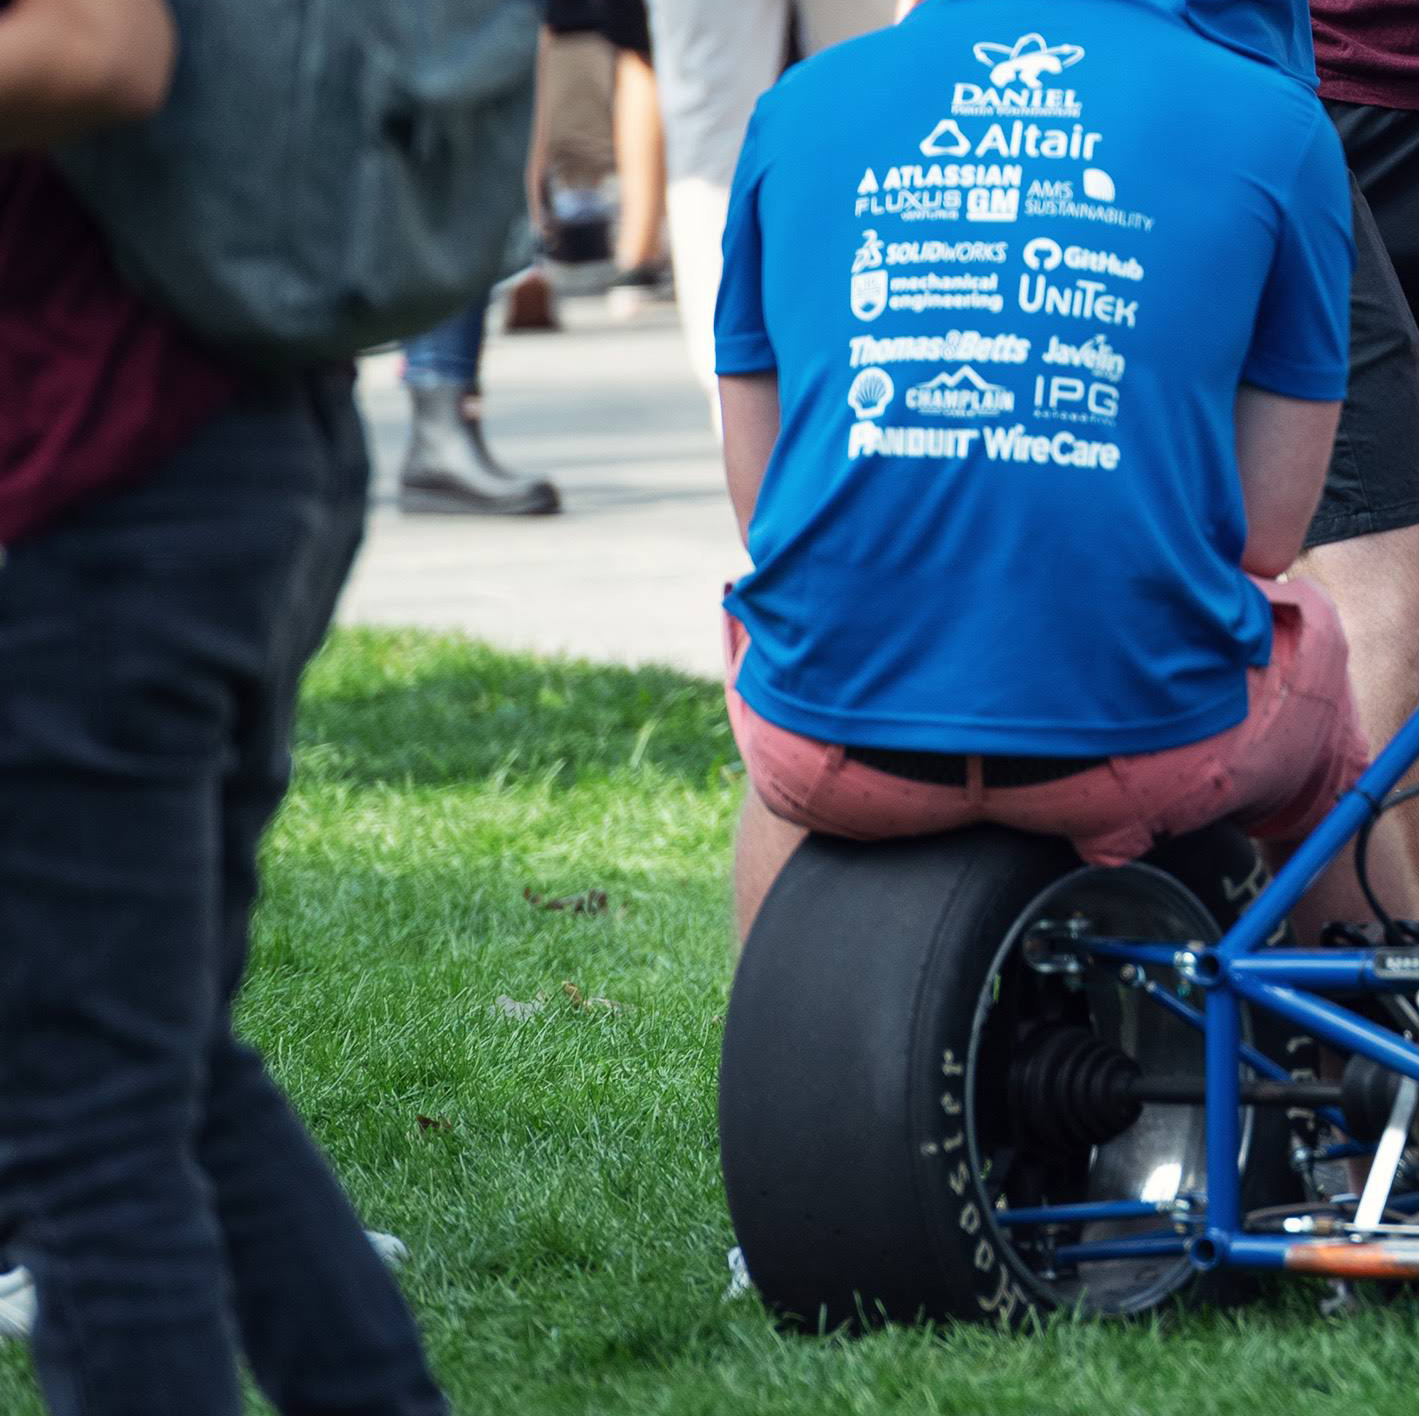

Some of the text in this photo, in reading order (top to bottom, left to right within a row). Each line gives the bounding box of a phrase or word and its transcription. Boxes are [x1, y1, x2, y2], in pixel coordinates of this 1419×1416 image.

[953, 82, 1082, 109] DANIEL
[974, 119, 1103, 161] Altair
[882, 163, 1023, 191] ATLASSIAN
[854, 187, 1020, 219] FLUXUS GM
[885, 240, 1008, 266] SOLIDWORKS
[1063, 244, 1145, 282] GitHub
[889, 271, 999, 293] mechanical
[888, 290, 1005, 314] engineering
[848, 329, 1126, 378] Thomas&Betts Javelin
[904, 374, 1120, 418] CHAMPLAIN IPG
[847, 420, 1121, 471] PANDUIT WireCare
